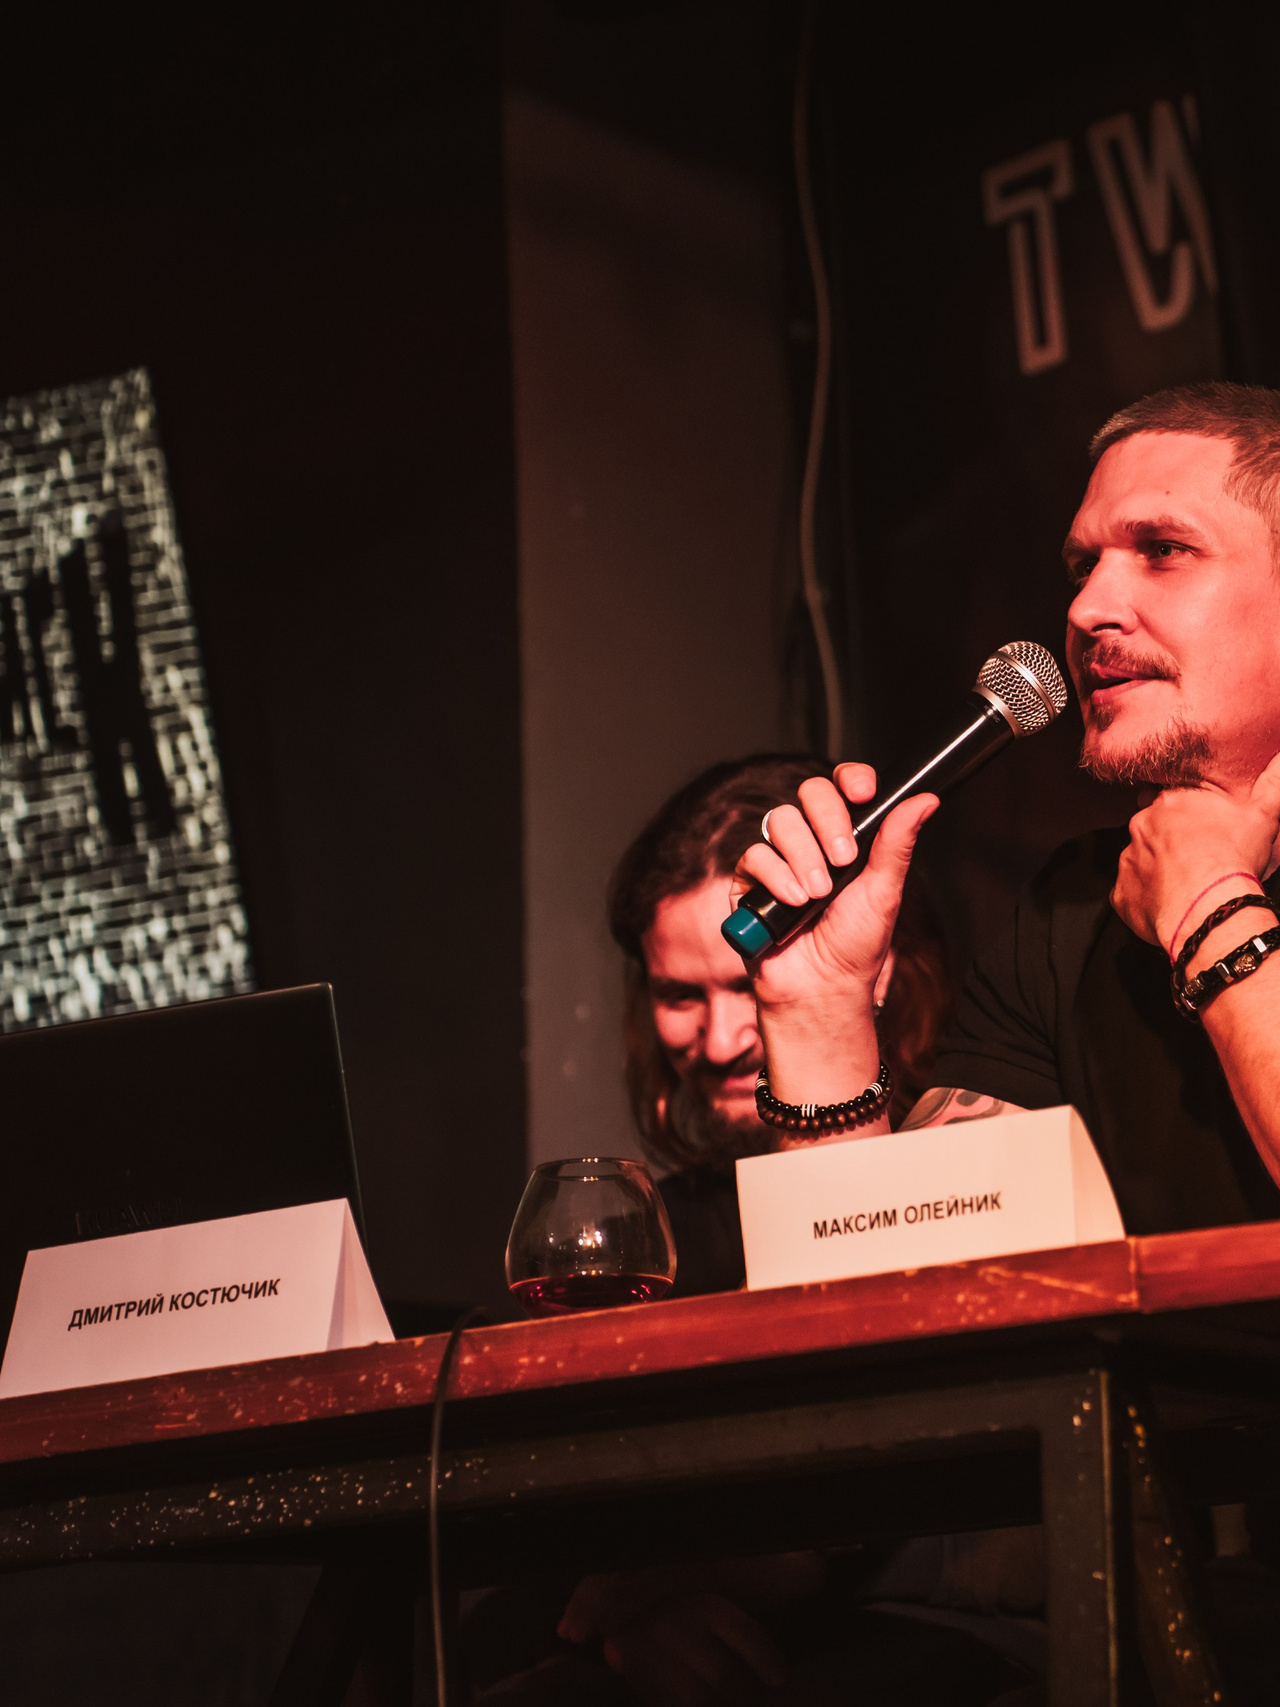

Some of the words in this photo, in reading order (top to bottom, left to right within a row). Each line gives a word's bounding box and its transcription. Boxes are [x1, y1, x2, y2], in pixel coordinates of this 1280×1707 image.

[812, 1208, 898, 1240] МАКСИМ
[903, 1192, 1003, 1225] ОЛЕЙНИК
[67, 1294, 166, 1332] ДМИТРИЙ
[168, 1278, 281, 1312] КОСТЮЧИК
